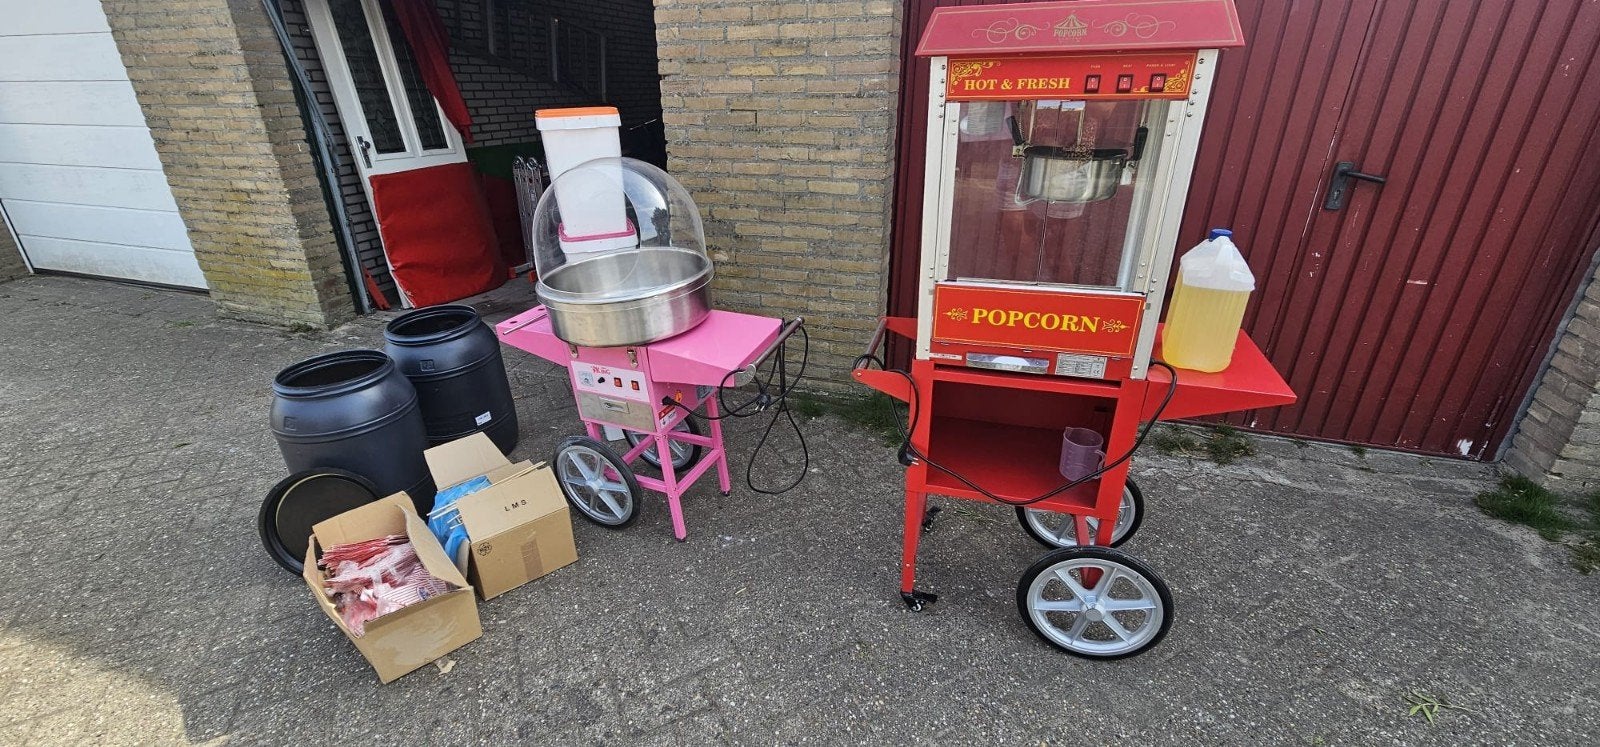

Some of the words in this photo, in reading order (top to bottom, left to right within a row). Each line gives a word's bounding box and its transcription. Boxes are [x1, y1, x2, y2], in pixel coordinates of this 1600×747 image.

[1053, 29, 1088, 38] POPCORN
[964, 79, 998, 91] HOT
[1001, 78, 1013, 90] &
[1016, 77, 1071, 90] FRESH
[971, 307, 1101, 333] POPCORN
